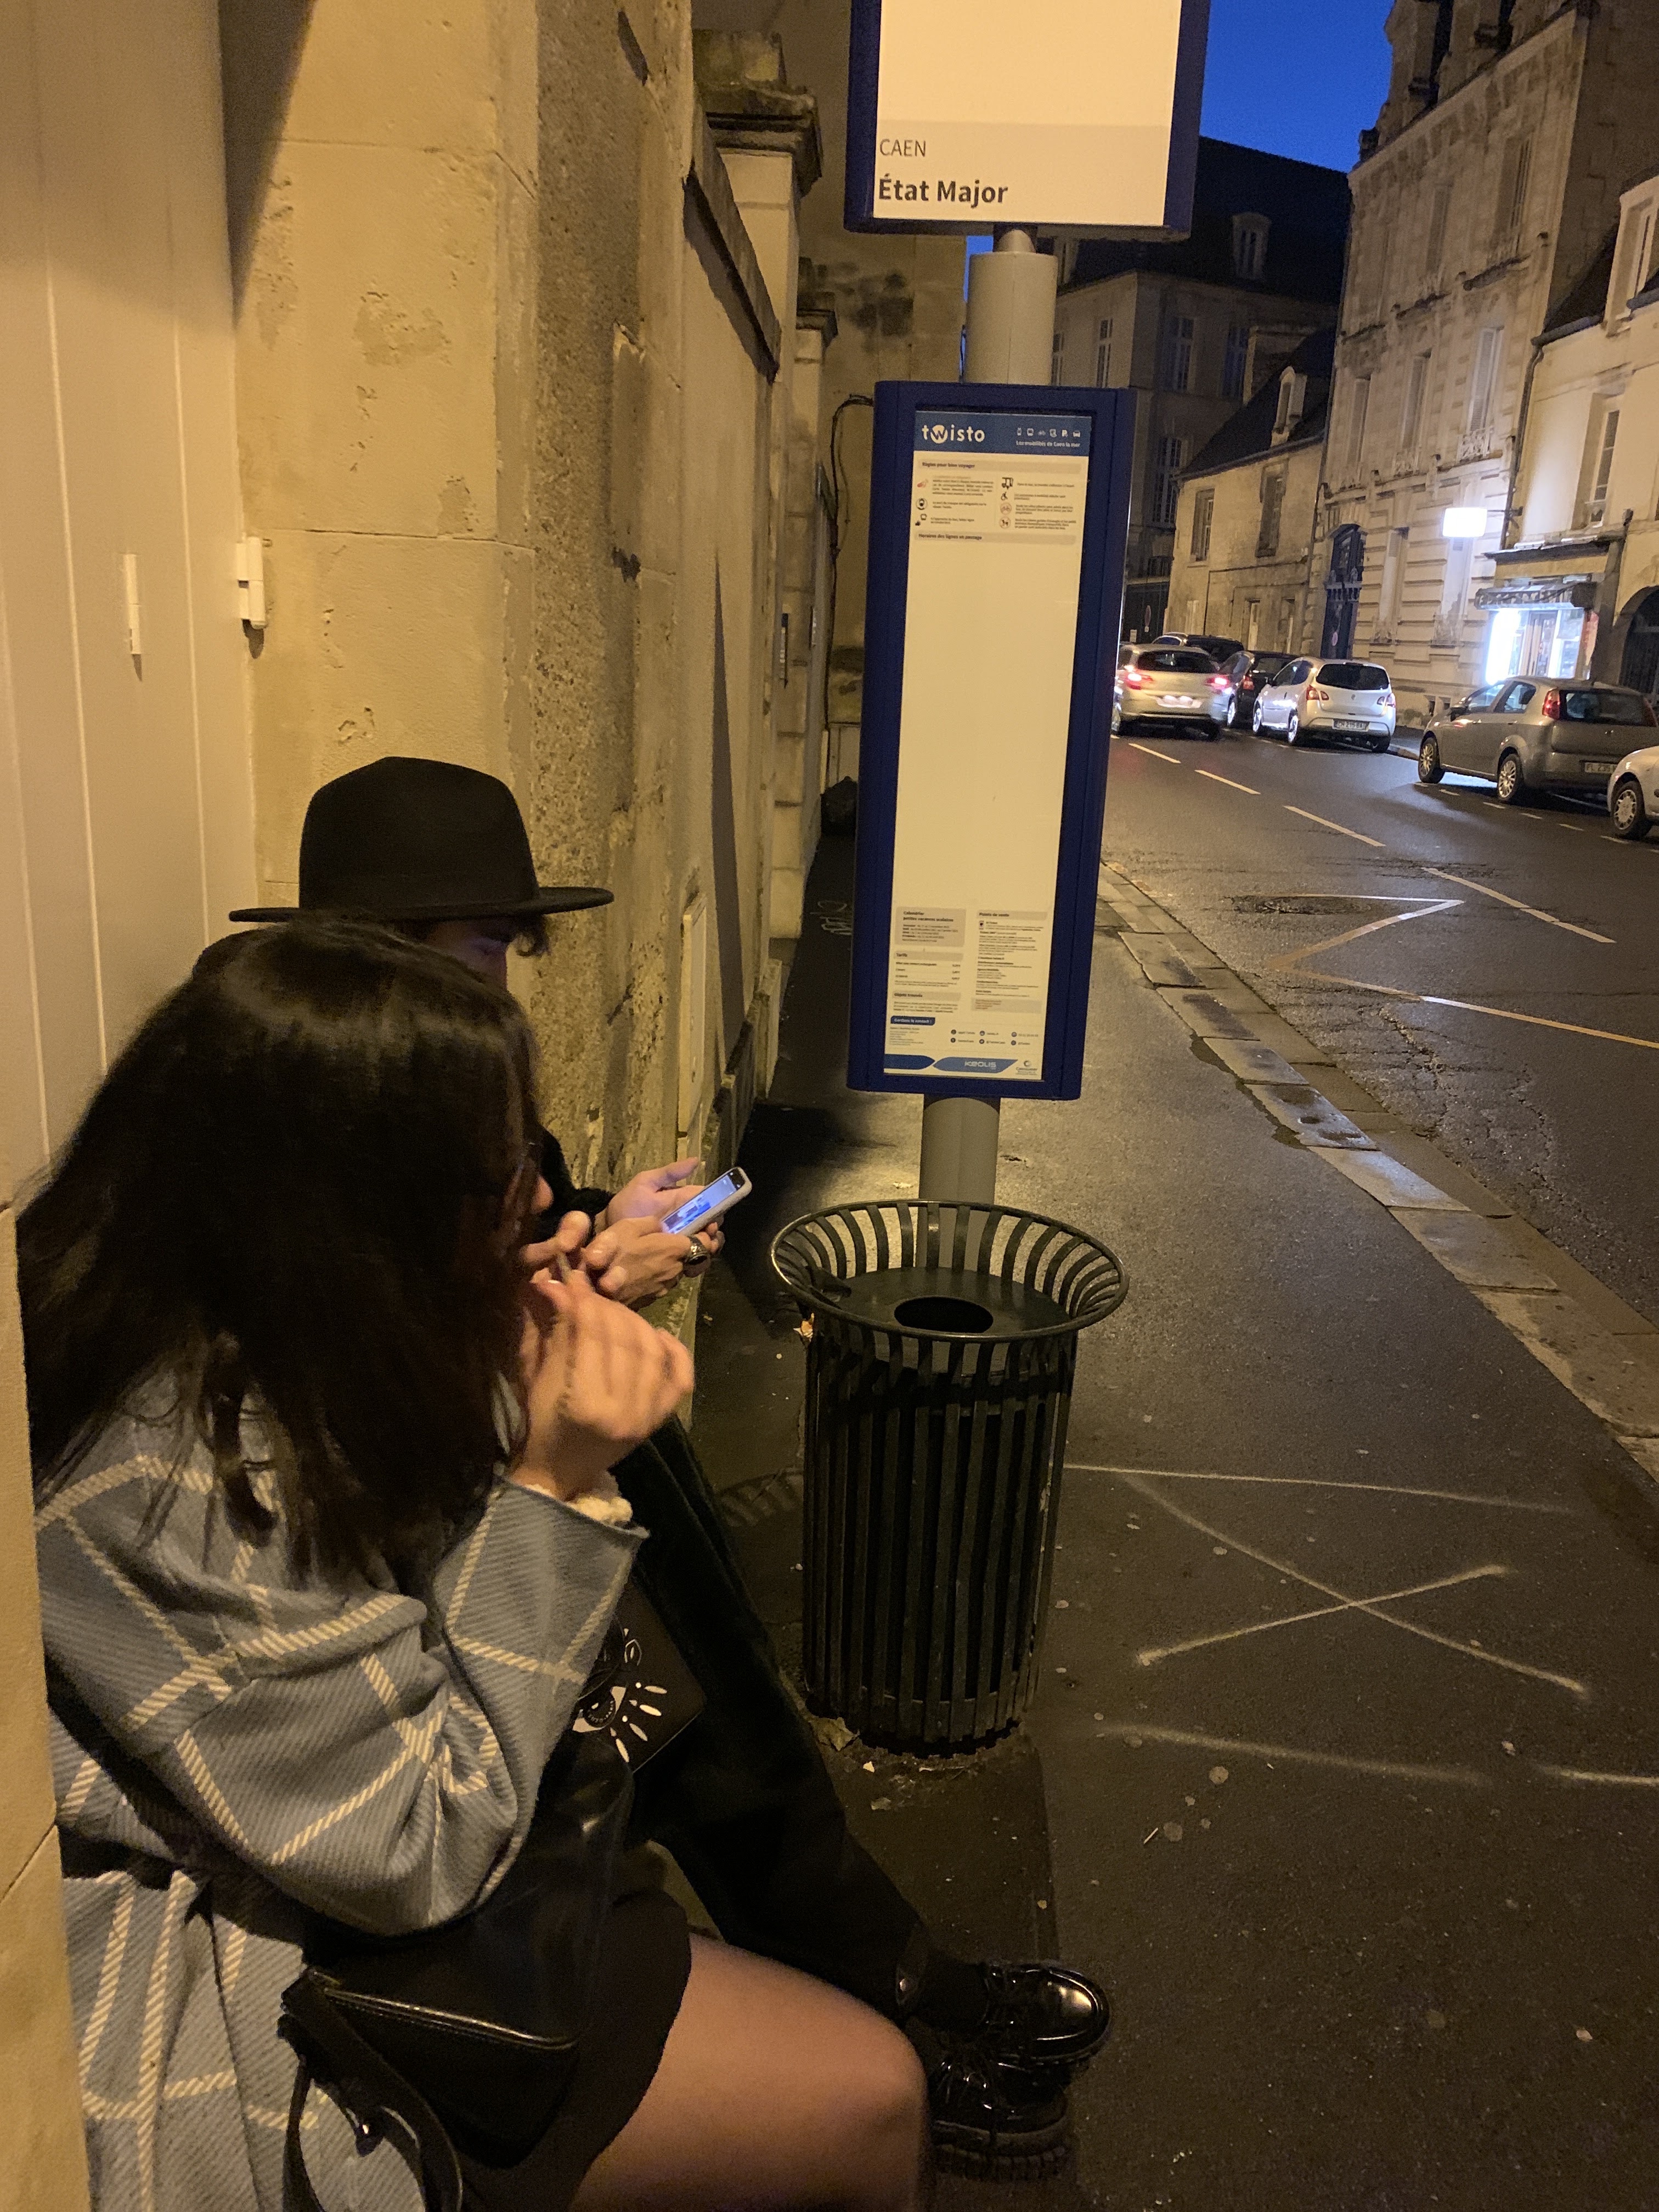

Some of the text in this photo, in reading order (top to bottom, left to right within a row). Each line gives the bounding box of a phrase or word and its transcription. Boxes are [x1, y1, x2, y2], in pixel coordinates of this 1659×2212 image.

[879, 139, 926, 157] CAEN
[879, 173, 1008, 208] État Major
[922, 424, 985, 444] twisto
